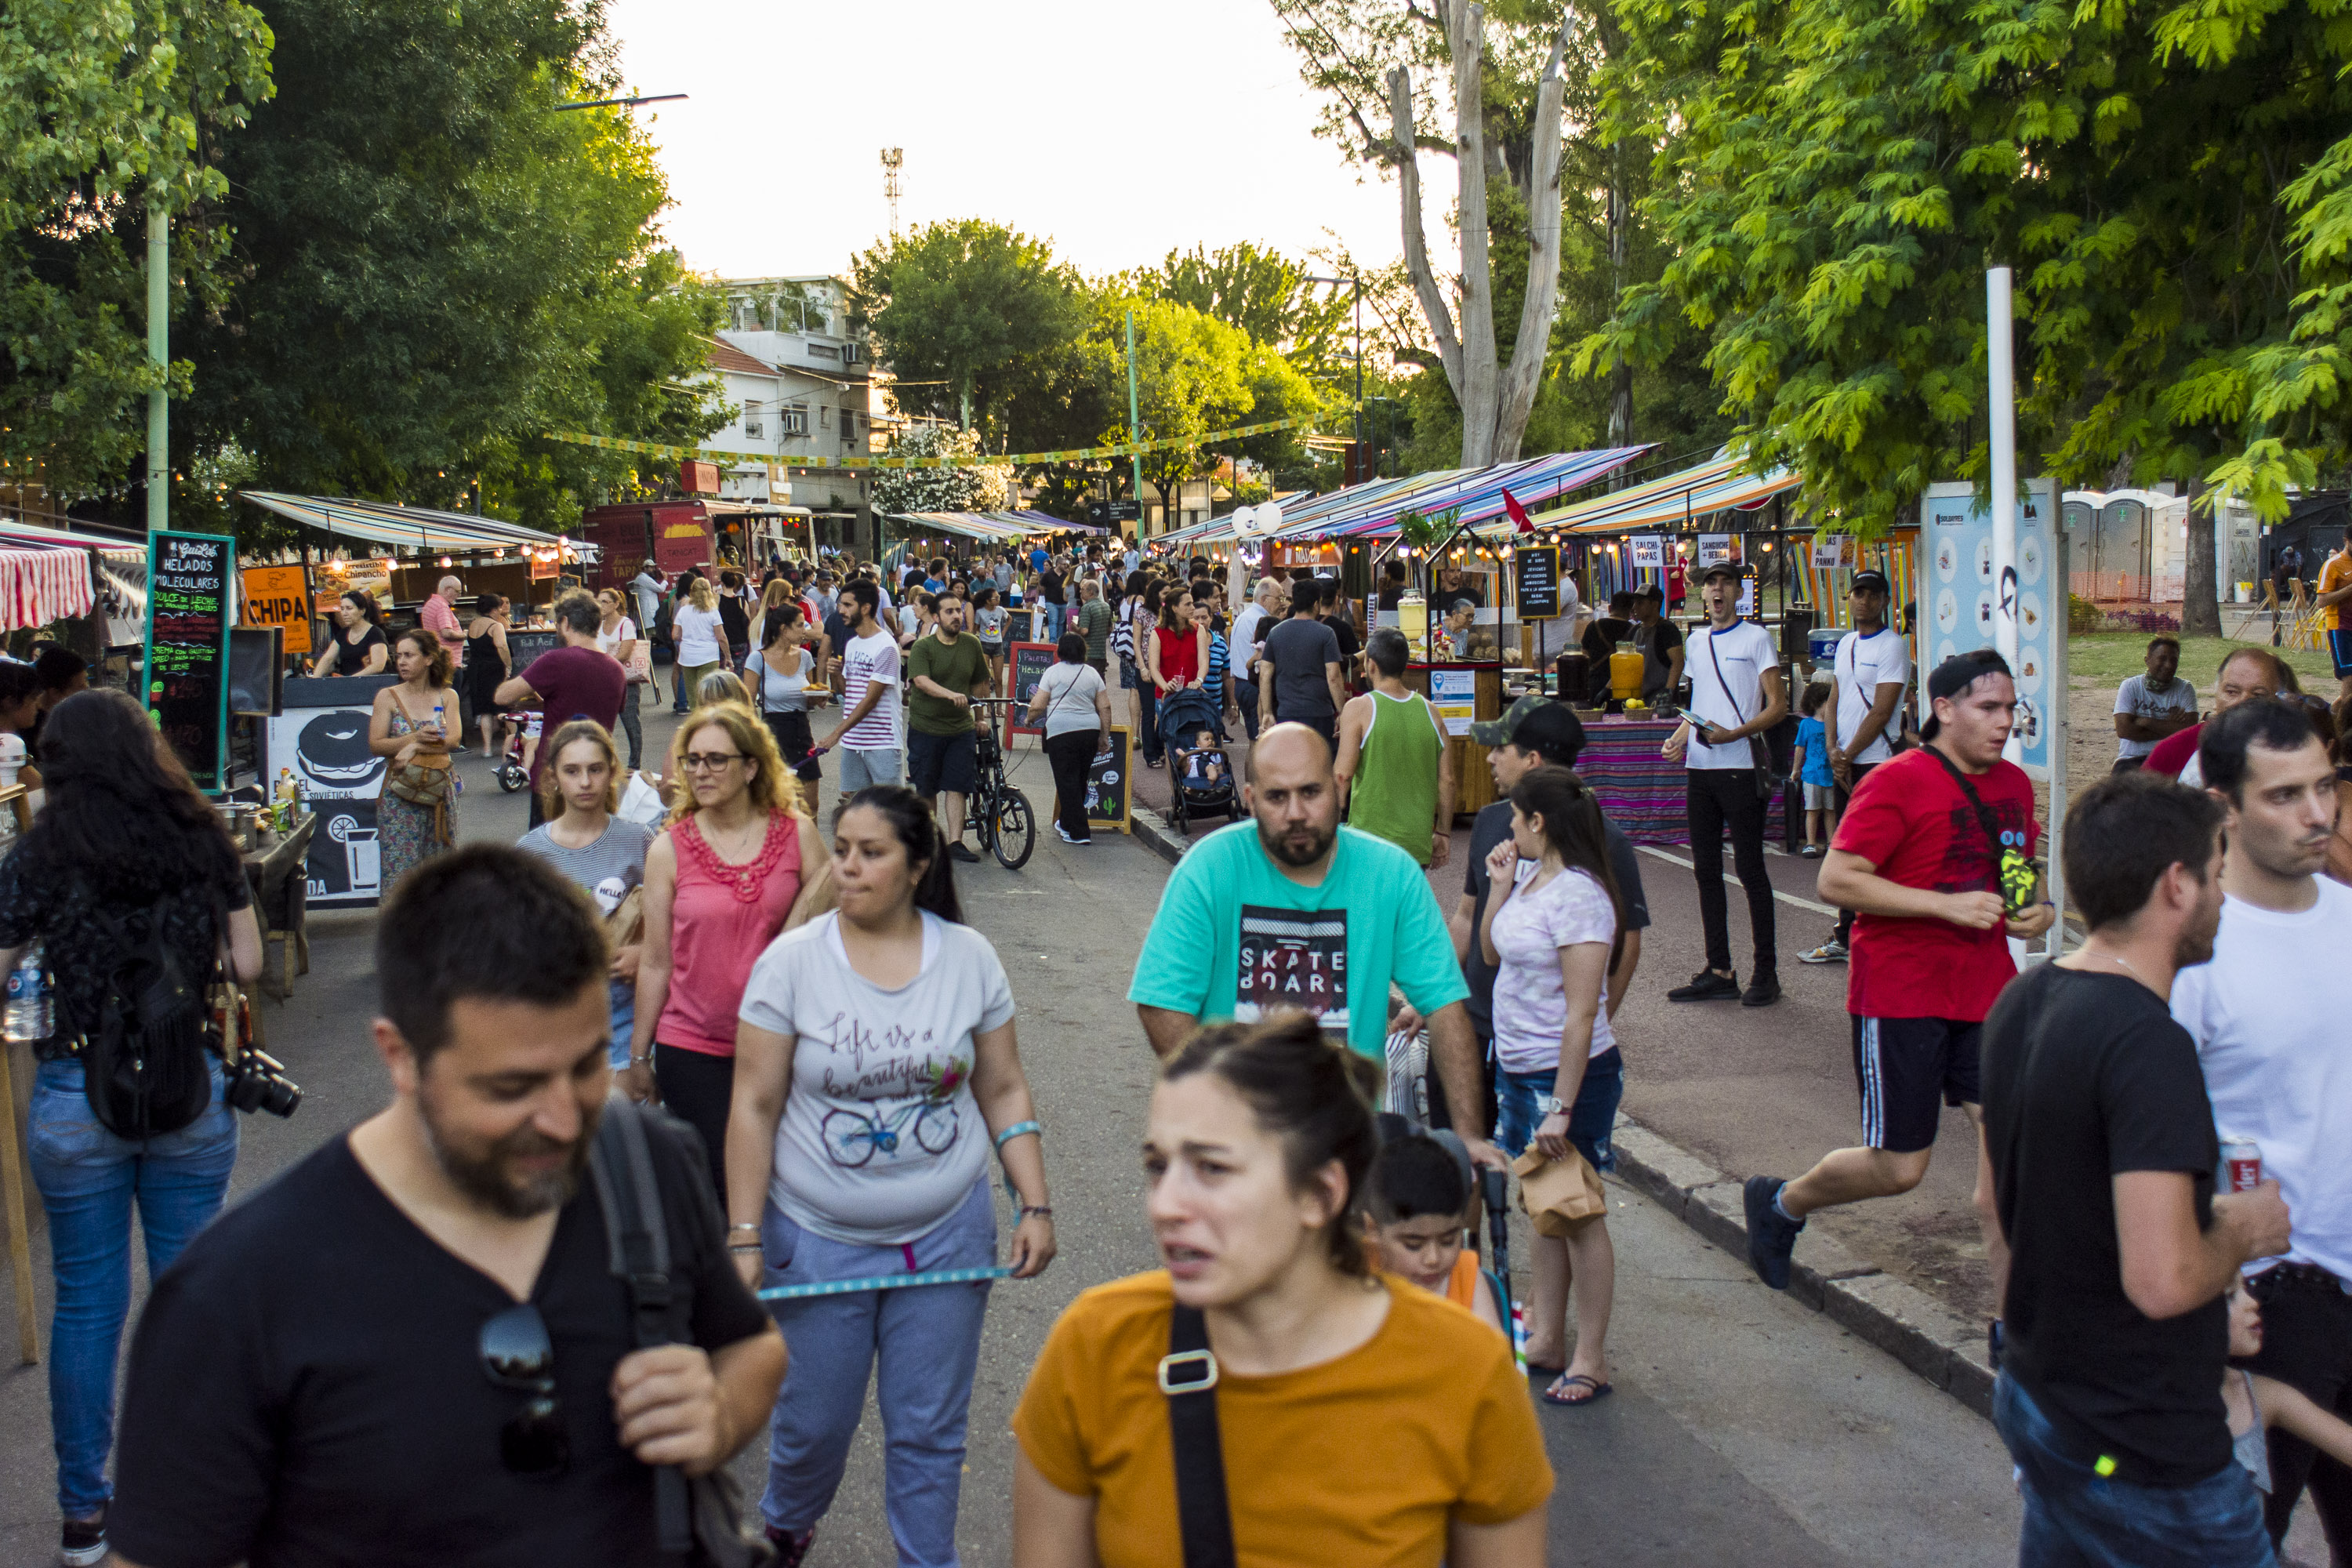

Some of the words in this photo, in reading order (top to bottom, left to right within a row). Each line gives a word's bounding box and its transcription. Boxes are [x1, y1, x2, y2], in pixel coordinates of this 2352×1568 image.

[1635, 541, 1660, 550] SALCHI-
[1637, 552, 1657, 561] PAPAS
[1816, 548, 1824, 557] AL
[164, 559, 213, 572] HELADOS
[345, 561, 387, 570] Irresistible
[1815, 557, 1835, 567] PANKO
[345, 571, 387, 579] Chipancho
[154, 575, 220, 590] MOLECULARES
[154, 591, 180, 603] DULCE
[249, 597, 308, 624] CHIPA
[151, 655, 170, 664] OREO
[1022, 666, 1047, 674] HeLad
[2134, 698, 2170, 713] Volco
[1241, 947, 1345, 971] SKATE
[820, 1011, 880, 1073] Life
[885, 1024, 916, 1049] is
[923, 1028, 934, 1041] a
[822, 1053, 935, 1098] beautiful
